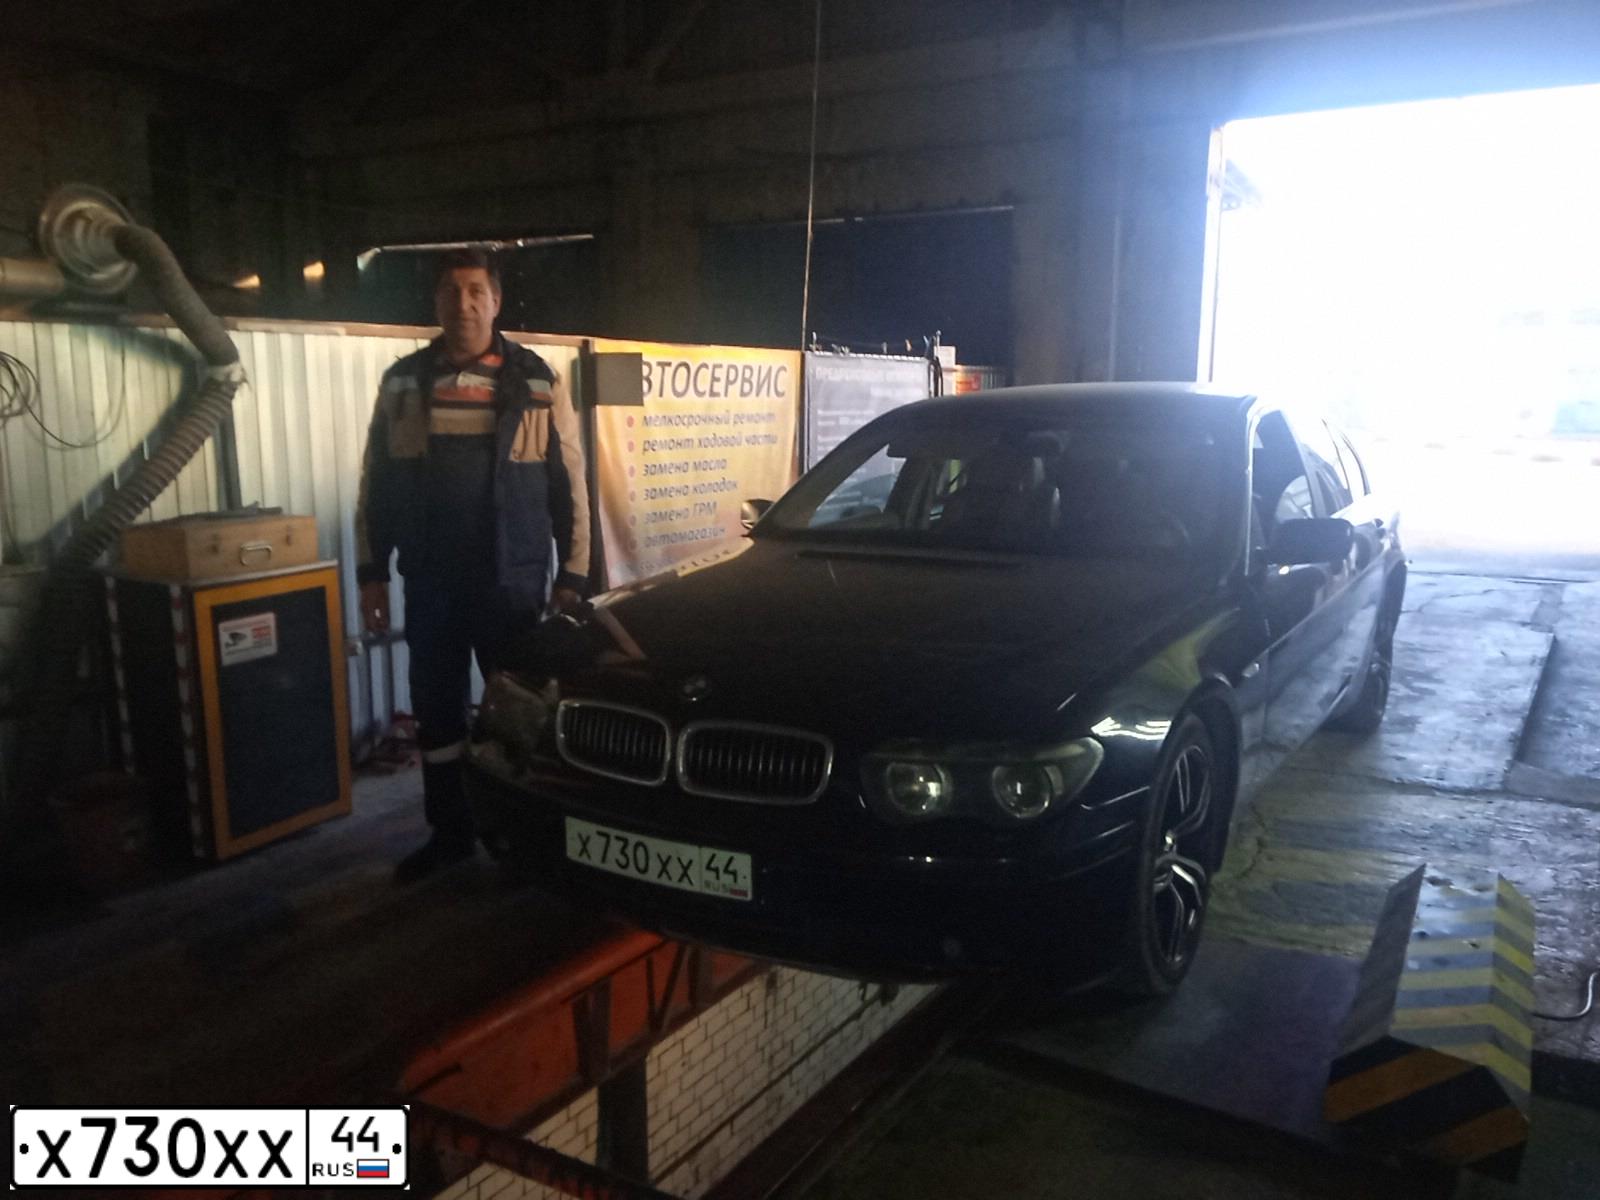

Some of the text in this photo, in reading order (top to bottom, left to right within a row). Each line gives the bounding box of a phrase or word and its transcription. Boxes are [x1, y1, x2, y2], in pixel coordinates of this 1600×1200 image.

[642, 360, 788, 398] ВТОСЕРВИС
[733, 411, 776, 427] ремонт
[642, 433, 778, 456] ремонт ходовой части
[642, 458, 727, 477] замена масла
[643, 476, 737, 500] замена колодок
[644, 501, 718, 524] замена ГРМ
[577, 830, 738, 886] Х730ХХ 44
